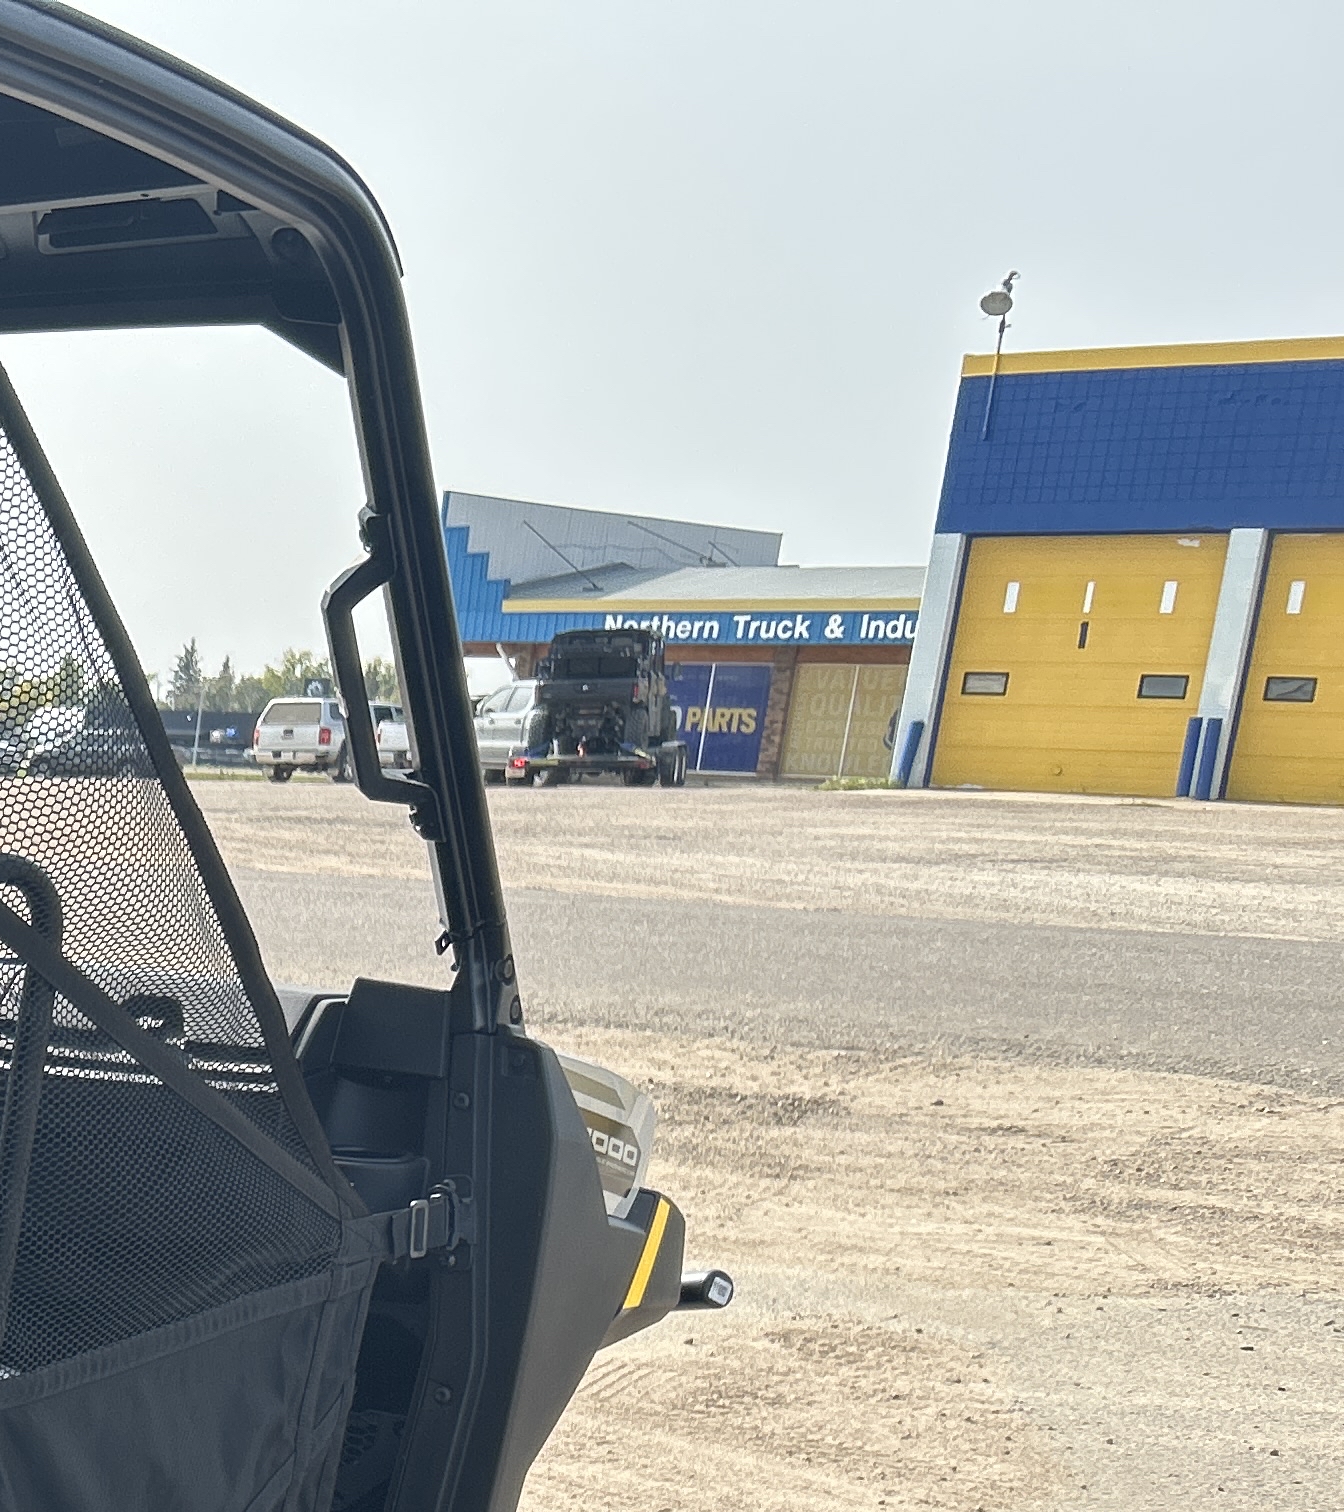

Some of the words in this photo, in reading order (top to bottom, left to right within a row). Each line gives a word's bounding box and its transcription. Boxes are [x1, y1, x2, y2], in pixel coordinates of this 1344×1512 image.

[733, 614, 811, 640] Truck
[824, 613, 845, 639] &
[685, 706, 758, 735] PARTS
